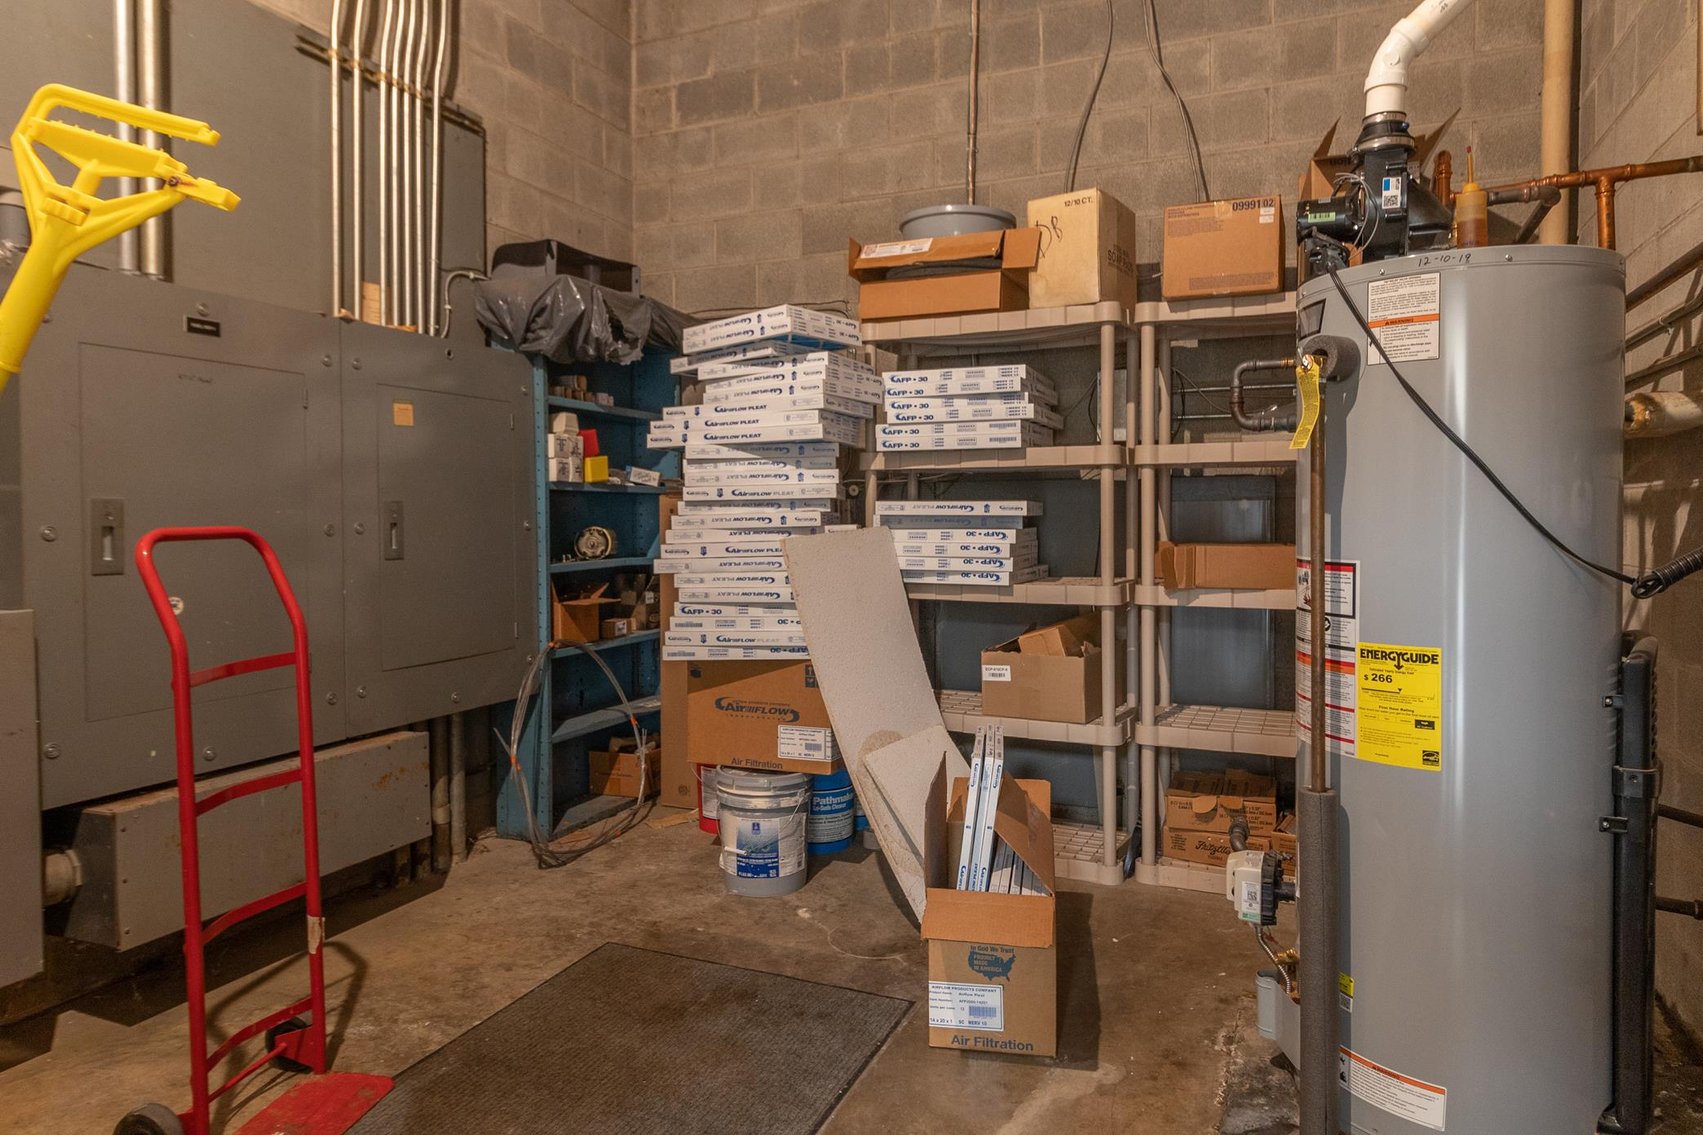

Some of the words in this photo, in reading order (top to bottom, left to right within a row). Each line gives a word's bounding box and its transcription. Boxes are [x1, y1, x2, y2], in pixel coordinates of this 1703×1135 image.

[1371, 673, 1393, 683] 266
[731, 757, 742, 766] Air
[745, 758, 784, 770] Filtration
[951, 1035, 970, 1046] Air
[974, 1036, 1034, 1052] Filtration
